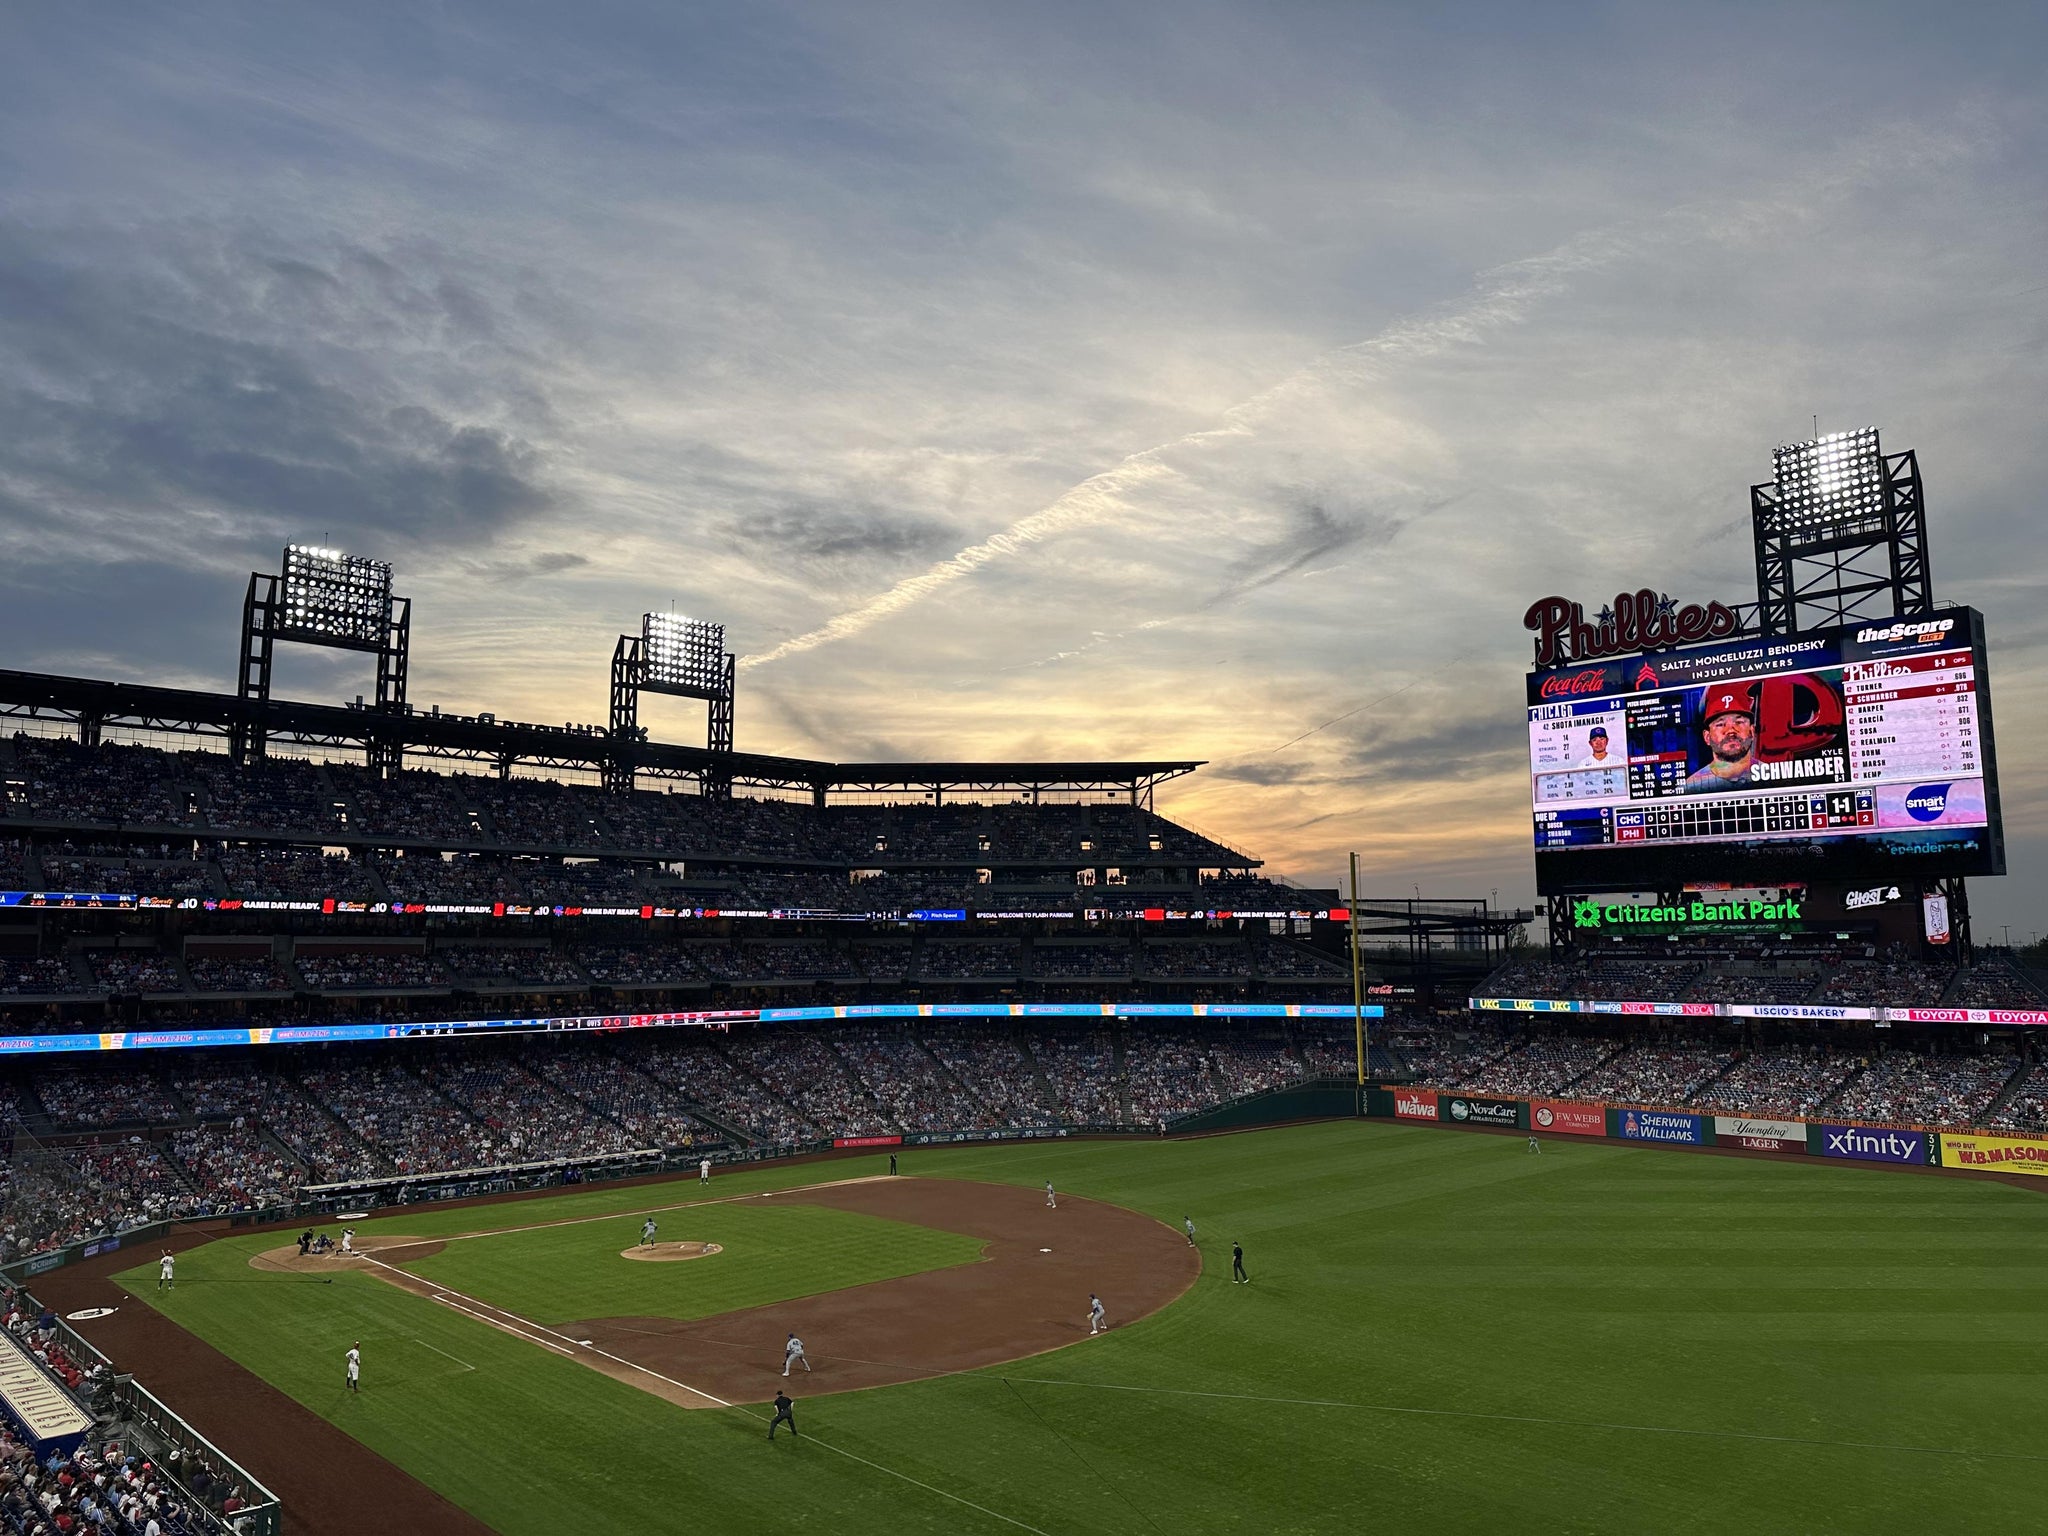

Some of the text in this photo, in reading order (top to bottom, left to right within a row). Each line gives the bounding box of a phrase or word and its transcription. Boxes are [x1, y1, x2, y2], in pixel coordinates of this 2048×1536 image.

[1524, 589, 1736, 665] Phillies
[1857, 619, 1954, 643] theScore
[1661, 639, 1826, 672] SALTZ MONGELUZZI BENDESKY
[1692, 658, 1793, 679] INJURY LAWYERS
[1843, 662, 1912, 682] Phillies
[1541, 668, 1608, 698] Coca-Cola
[1856, 683, 1882, 692] TURNER
[1721, 695, 1734, 709] P
[1857, 691, 1898, 703] SCHWARBER
[1532, 705, 1573, 721] CHICAGO
[1858, 704, 1884, 713] HARPER
[1552, 720, 1573, 730] SHOTA
[1574, 717, 1604, 727] IMANAGA
[1858, 715, 1884, 724] GARCÍA
[1859, 727, 1877, 735] SOSA
[1860, 736, 1896, 746] REALMUTO
[1563, 743, 1569, 751] 27
[1821, 748, 1843, 756] KYLE
[1861, 740, 1972, 757] BOHM .441
[1750, 756, 1845, 782] SCHWARBER
[1862, 760, 1886, 768] MARSH
[1863, 771, 1881, 779] KEMP
[1832, 796, 1850, 813] 1-1
[1906, 795, 1945, 808] smart
[1535, 812, 1558, 822] DUE UP
[1620, 815, 1641, 825] CHC
[1769, 806, 1775, 814] 3
[1784, 805, 1789, 813] 3
[1798, 804, 1804, 812] 0
[1815, 803, 1822, 811] 4
[1623, 829, 1639, 838] PHI
[1785, 819, 1791, 827] 2
[1800, 818, 1805, 826] 1
[1816, 817, 1823, 825] 3
[184, 898, 198, 908] 10
[1846, 886, 1889, 910] GHOST
[375, 902, 387, 912] 10
[539, 906, 549, 915] 10
[1605, 898, 1801, 923] Citizens Bank Park
[682, 908, 691, 917] 10
[1320, 911, 1328, 919] 10
[1368, 984, 1394, 994] Coca-Cola
[1480, 999, 1499, 1009] UKG
[1514, 1000, 1534, 1010] UKG
[1549, 1001, 1570, 1011] UKG
[1625, 1003, 1650, 1013] NECA
[1685, 1004, 1713, 1015] NECA
[1754, 1006, 1846, 1018] LISCIO'S BAKERY
[1913, 1010, 1964, 1020] TOYOTA
[1993, 1011, 2048, 1022] TOYOTA
[1434, 1088, 1467, 1097] ASPLUNDH
[1473, 1092, 1508, 1100] ASPLUNDH
[1514, 1095, 1550, 1103] ASPLUNDH
[1557, 1099, 1595, 1107] ASPLUNDH
[1397, 1099, 1436, 1117] Wawa
[1469, 1102, 1517, 1118] NovaCare
[1602, 1102, 1642, 1111] ASPLUNDH
[1650, 1105, 1690, 1114] ASPLUNDH
[1574, 1113, 1600, 1124] WEBB
[1698, 1109, 1741, 1118] ASPLUNDH
[1750, 1113, 1795, 1122] ASPLUNDH
[1469, 1115, 1515, 1124] REHABILITATION
[1641, 1113, 1692, 1129] SHERWIN
[1804, 1117, 1851, 1127] ASPLUNDH
[1566, 1121, 1590, 1129] COMPANY
[1732, 1119, 1789, 1137] Yuengling
[1861, 1121, 1912, 1130] ASPLUNDH
[1025, 1130, 1033, 1138] 10
[1059, 1129, 1067, 1137] 10
[1922, 1126, 1975, 1136] ASPLUNDH
[1987, 1131, 2043, 1140] ASPLUNDH
[920, 1135, 928, 1143] 10
[1742, 1137, 1780, 1149] LAGER
[1828, 1128, 1917, 1159] xfinity
[2, 1377, 81, 1429] PHILLIES
